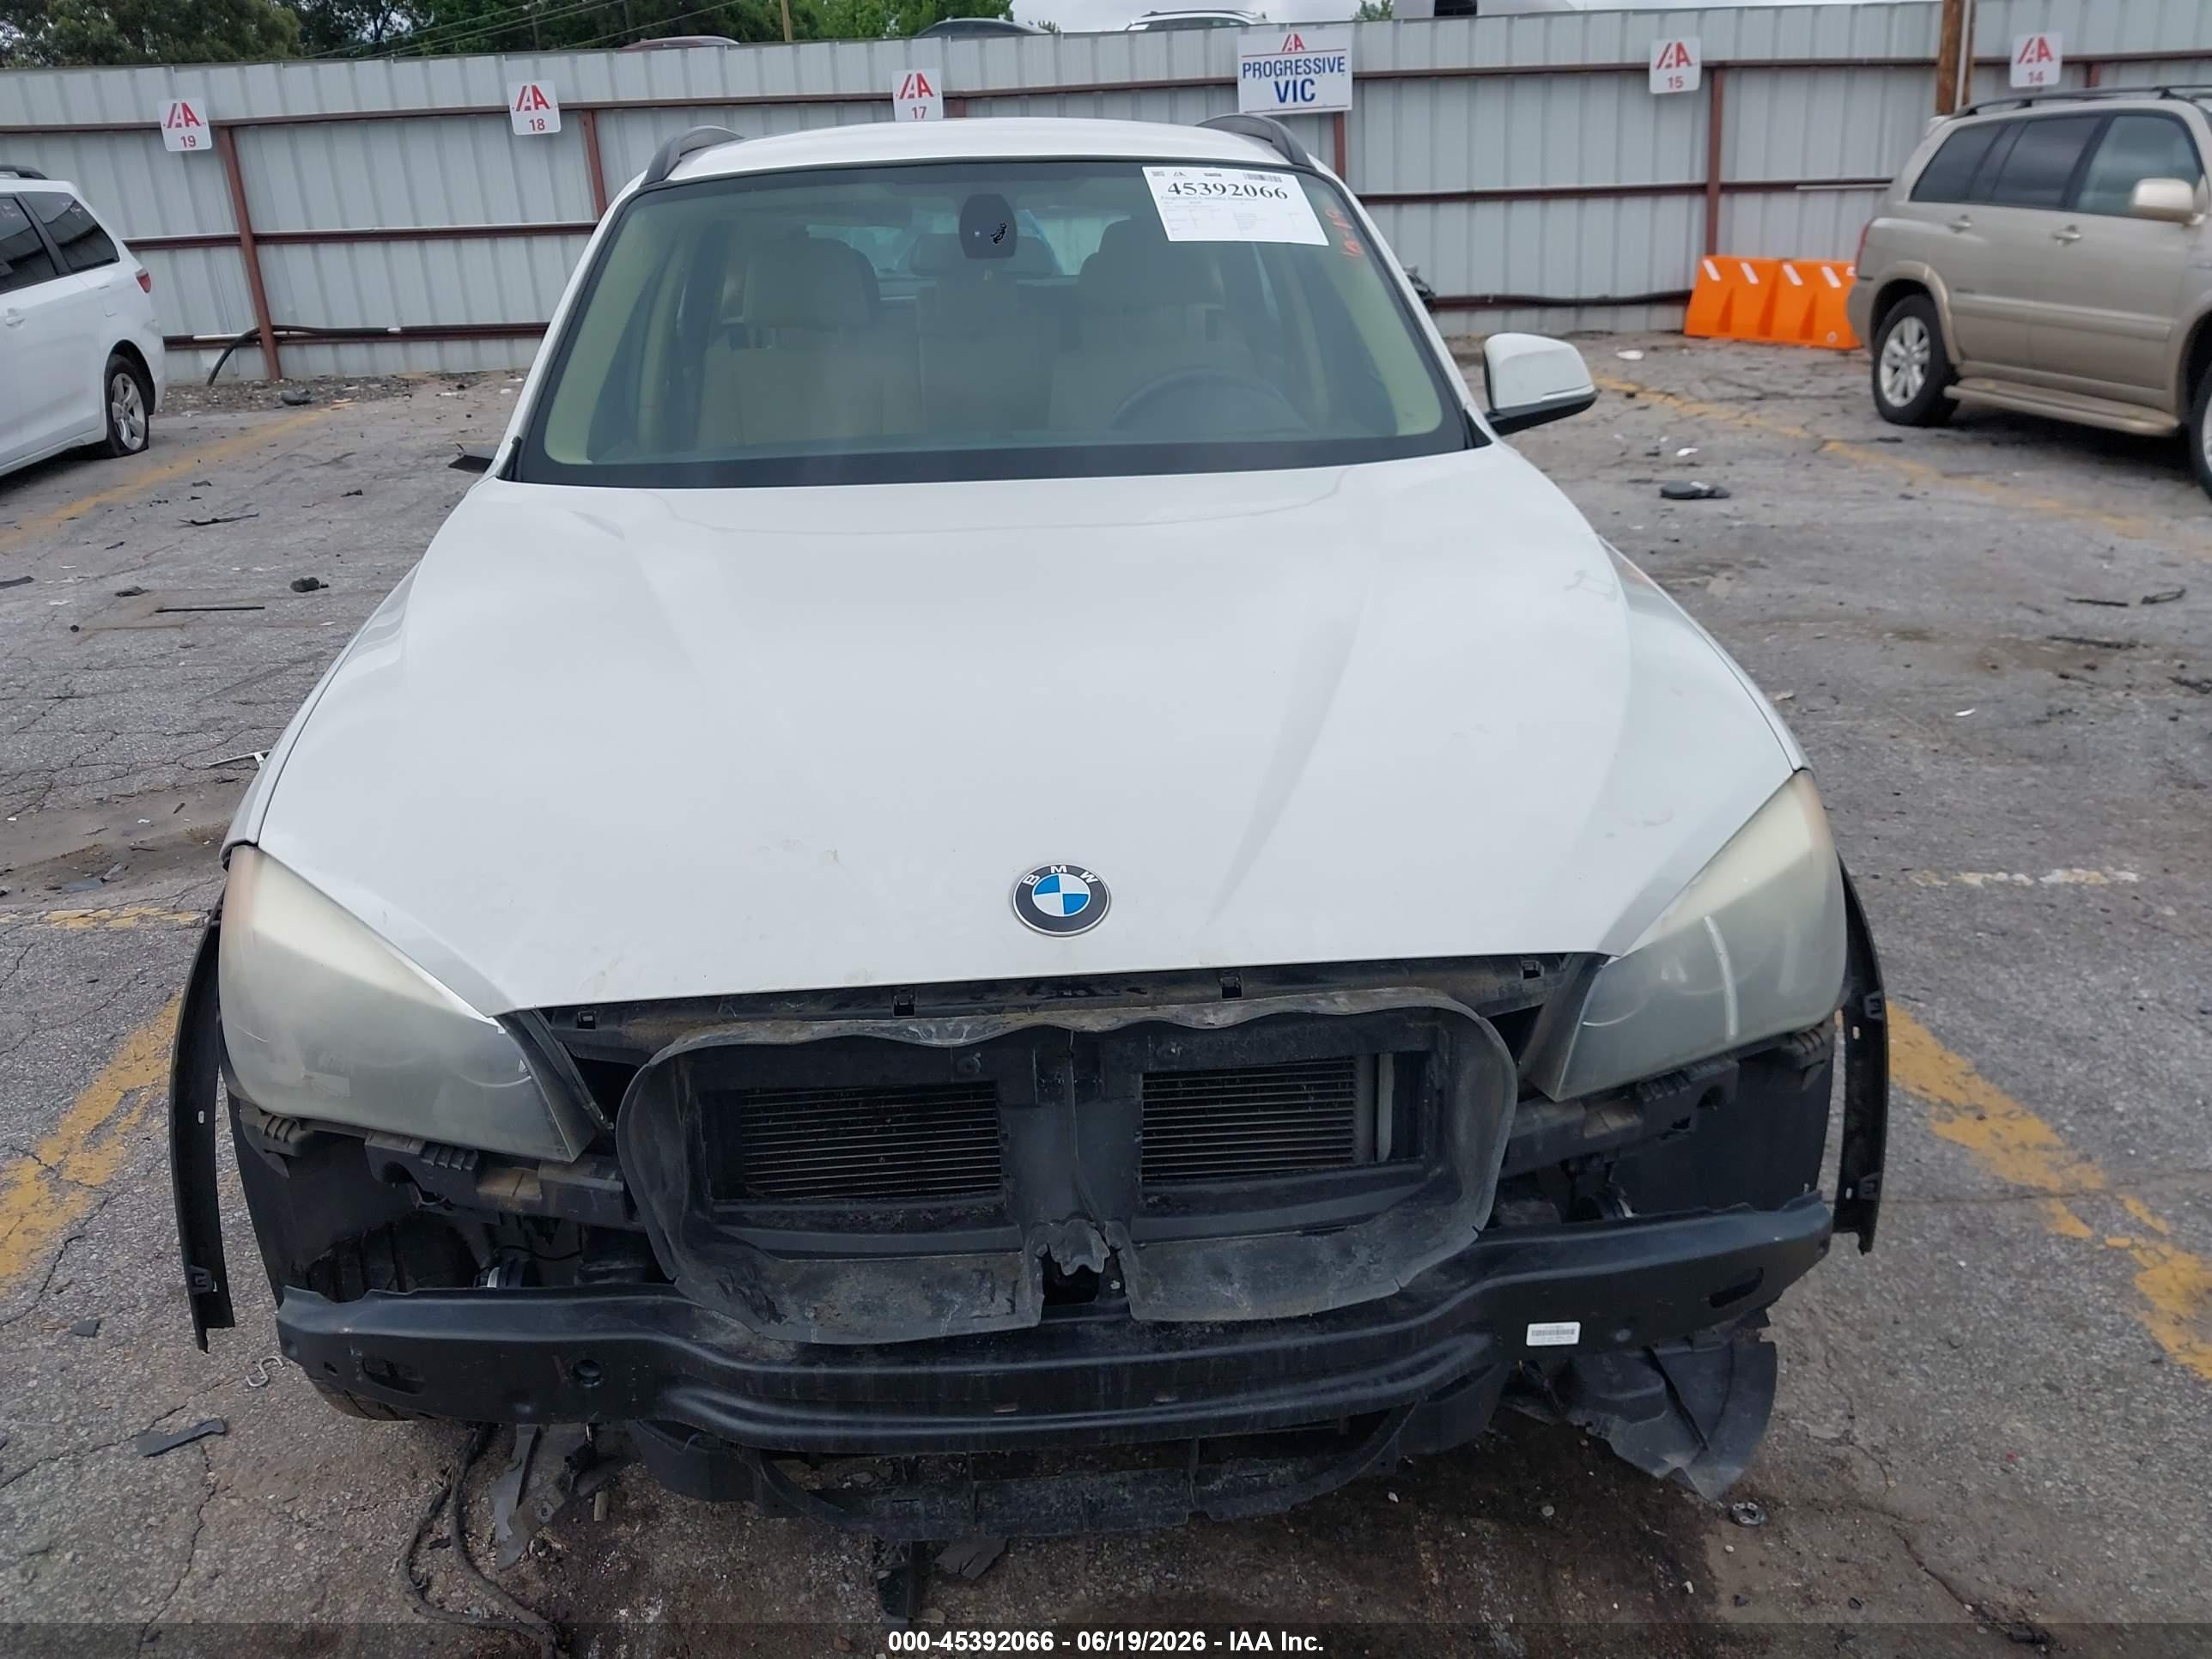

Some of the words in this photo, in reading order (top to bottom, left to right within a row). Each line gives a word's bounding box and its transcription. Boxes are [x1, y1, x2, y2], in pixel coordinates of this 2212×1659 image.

[1243, 56, 1346, 80] PROGRESSIVE
[1668, 76, 1685, 89] 15
[1273, 78, 1316, 104] VIC
[911, 106, 927, 119] 17
[529, 118, 545, 131] 18
[180, 135, 197, 148] 19
[1167, 181, 1289, 200] 45392066
[1022, 865, 1100, 886] BMW
